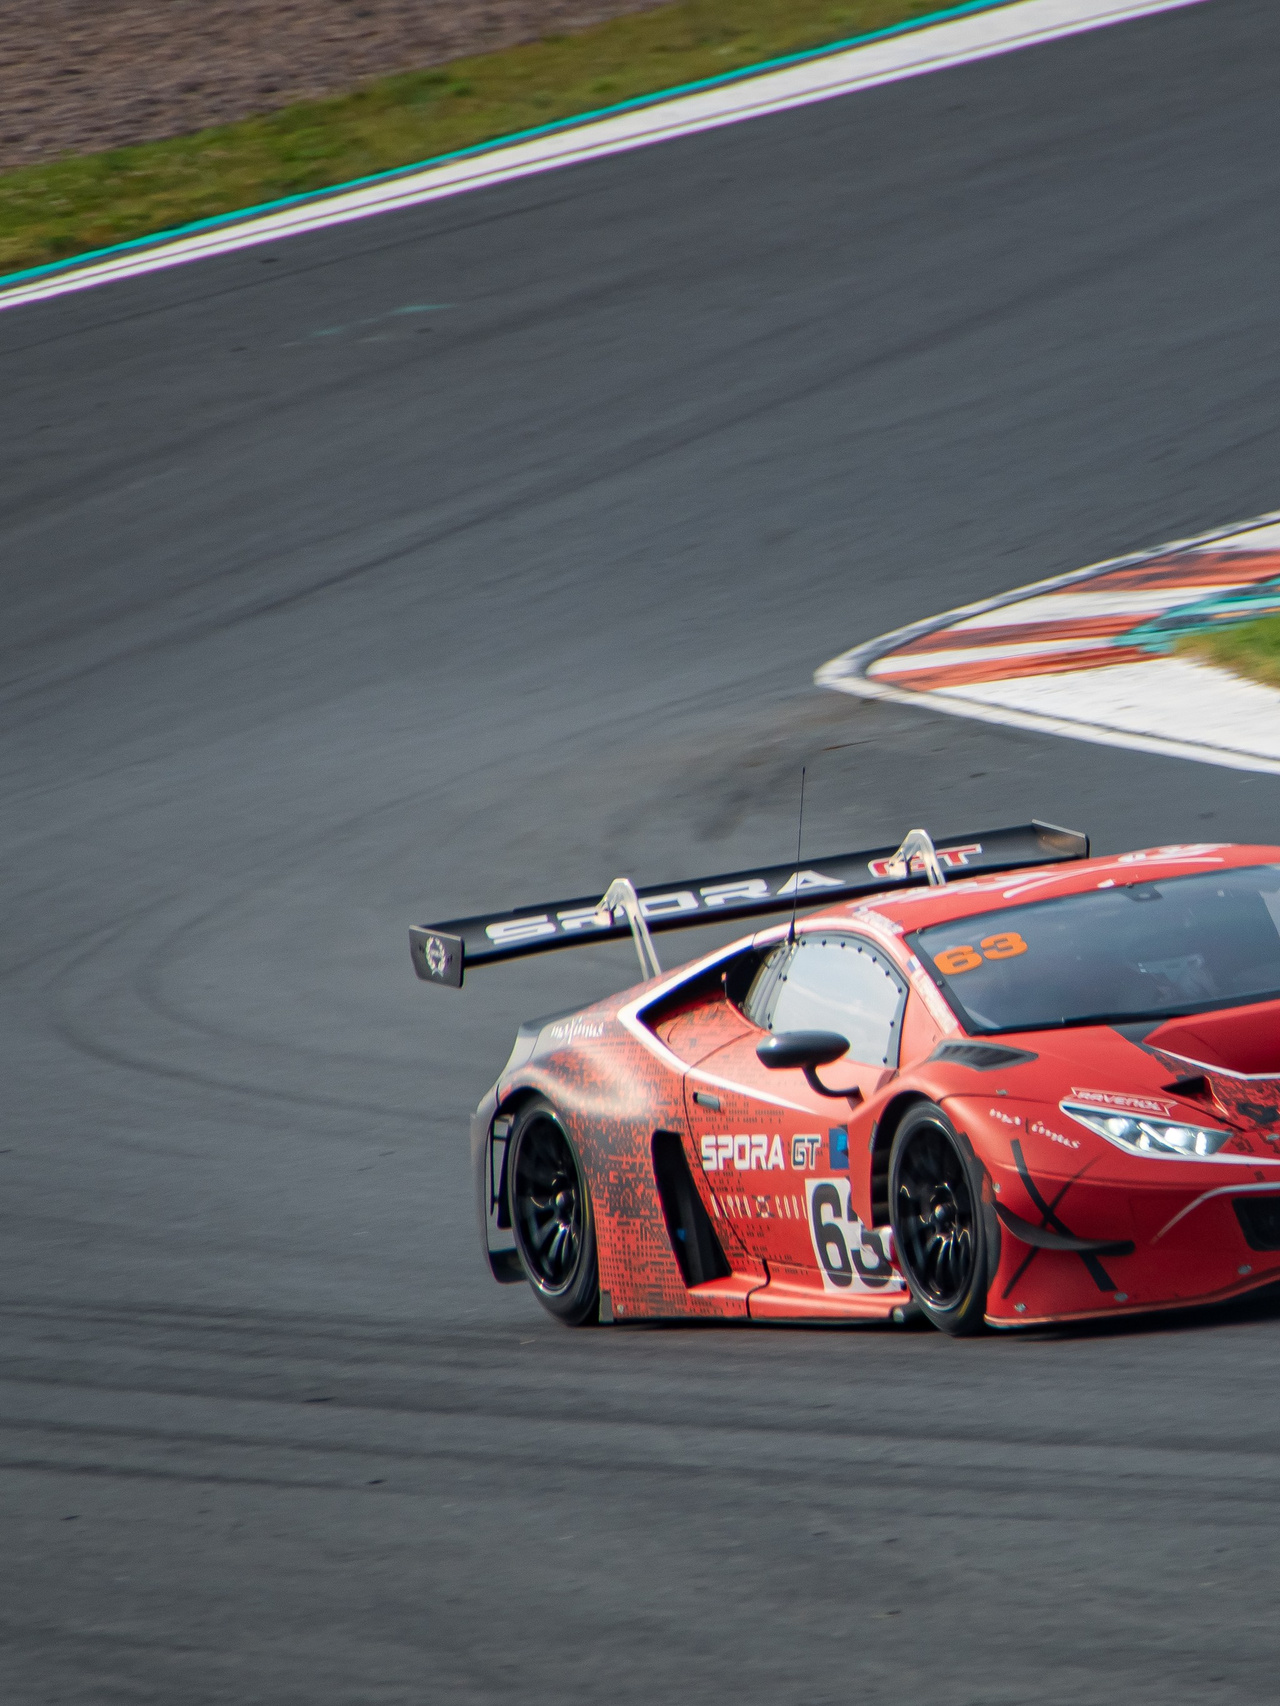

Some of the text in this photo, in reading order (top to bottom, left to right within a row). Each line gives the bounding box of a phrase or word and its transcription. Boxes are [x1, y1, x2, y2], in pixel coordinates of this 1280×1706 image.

[485, 870, 845, 945] SPORA
[933, 931, 1029, 976] 63
[701, 1133, 822, 1171] SPORA GT
